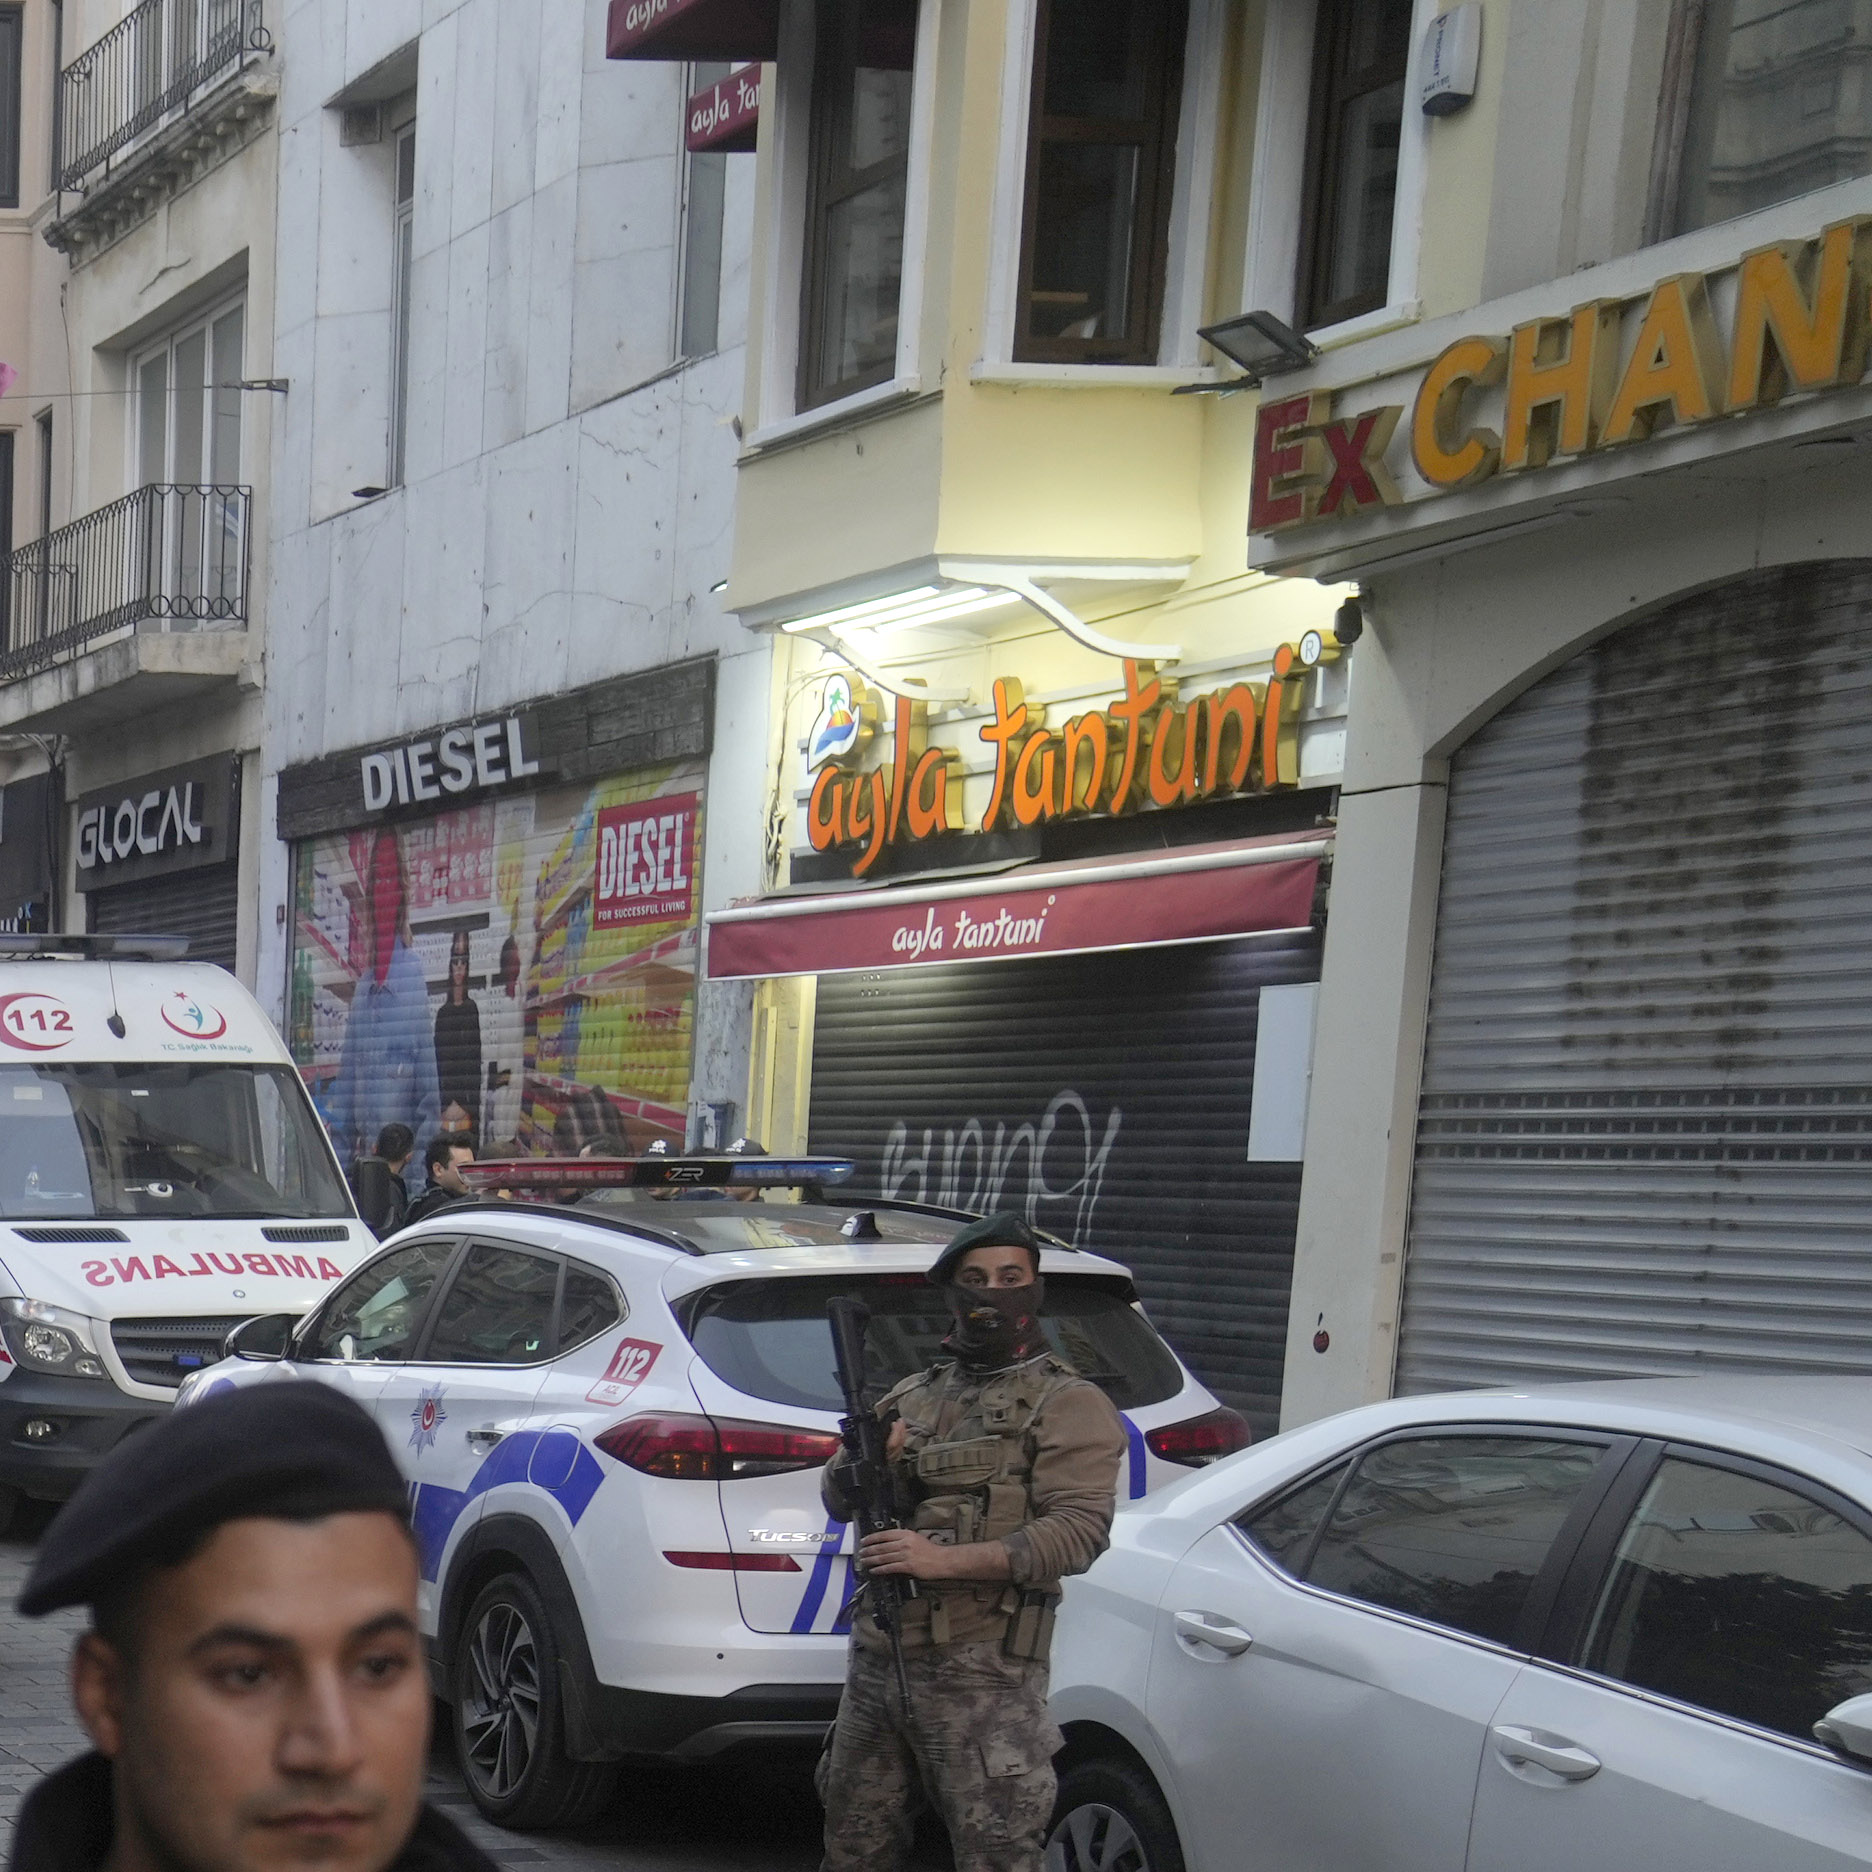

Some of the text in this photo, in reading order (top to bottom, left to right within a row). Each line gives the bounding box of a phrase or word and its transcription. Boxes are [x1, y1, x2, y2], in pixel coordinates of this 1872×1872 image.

[691, 84, 730, 136] ayla
[360, 718, 539, 812] DIESEL
[807, 690, 951, 878] ayla
[981, 658, 1294, 833] tantuni
[75, 781, 202, 870] GLOCAL
[598, 812, 687, 900] DIESEL
[598, 899, 686, 922] FOR SUCCESSFUL LIVING
[892, 907, 1048, 960] ayla tantuni
[7, 1009, 74, 1031] 112
[611, 1345, 651, 1382] 112
